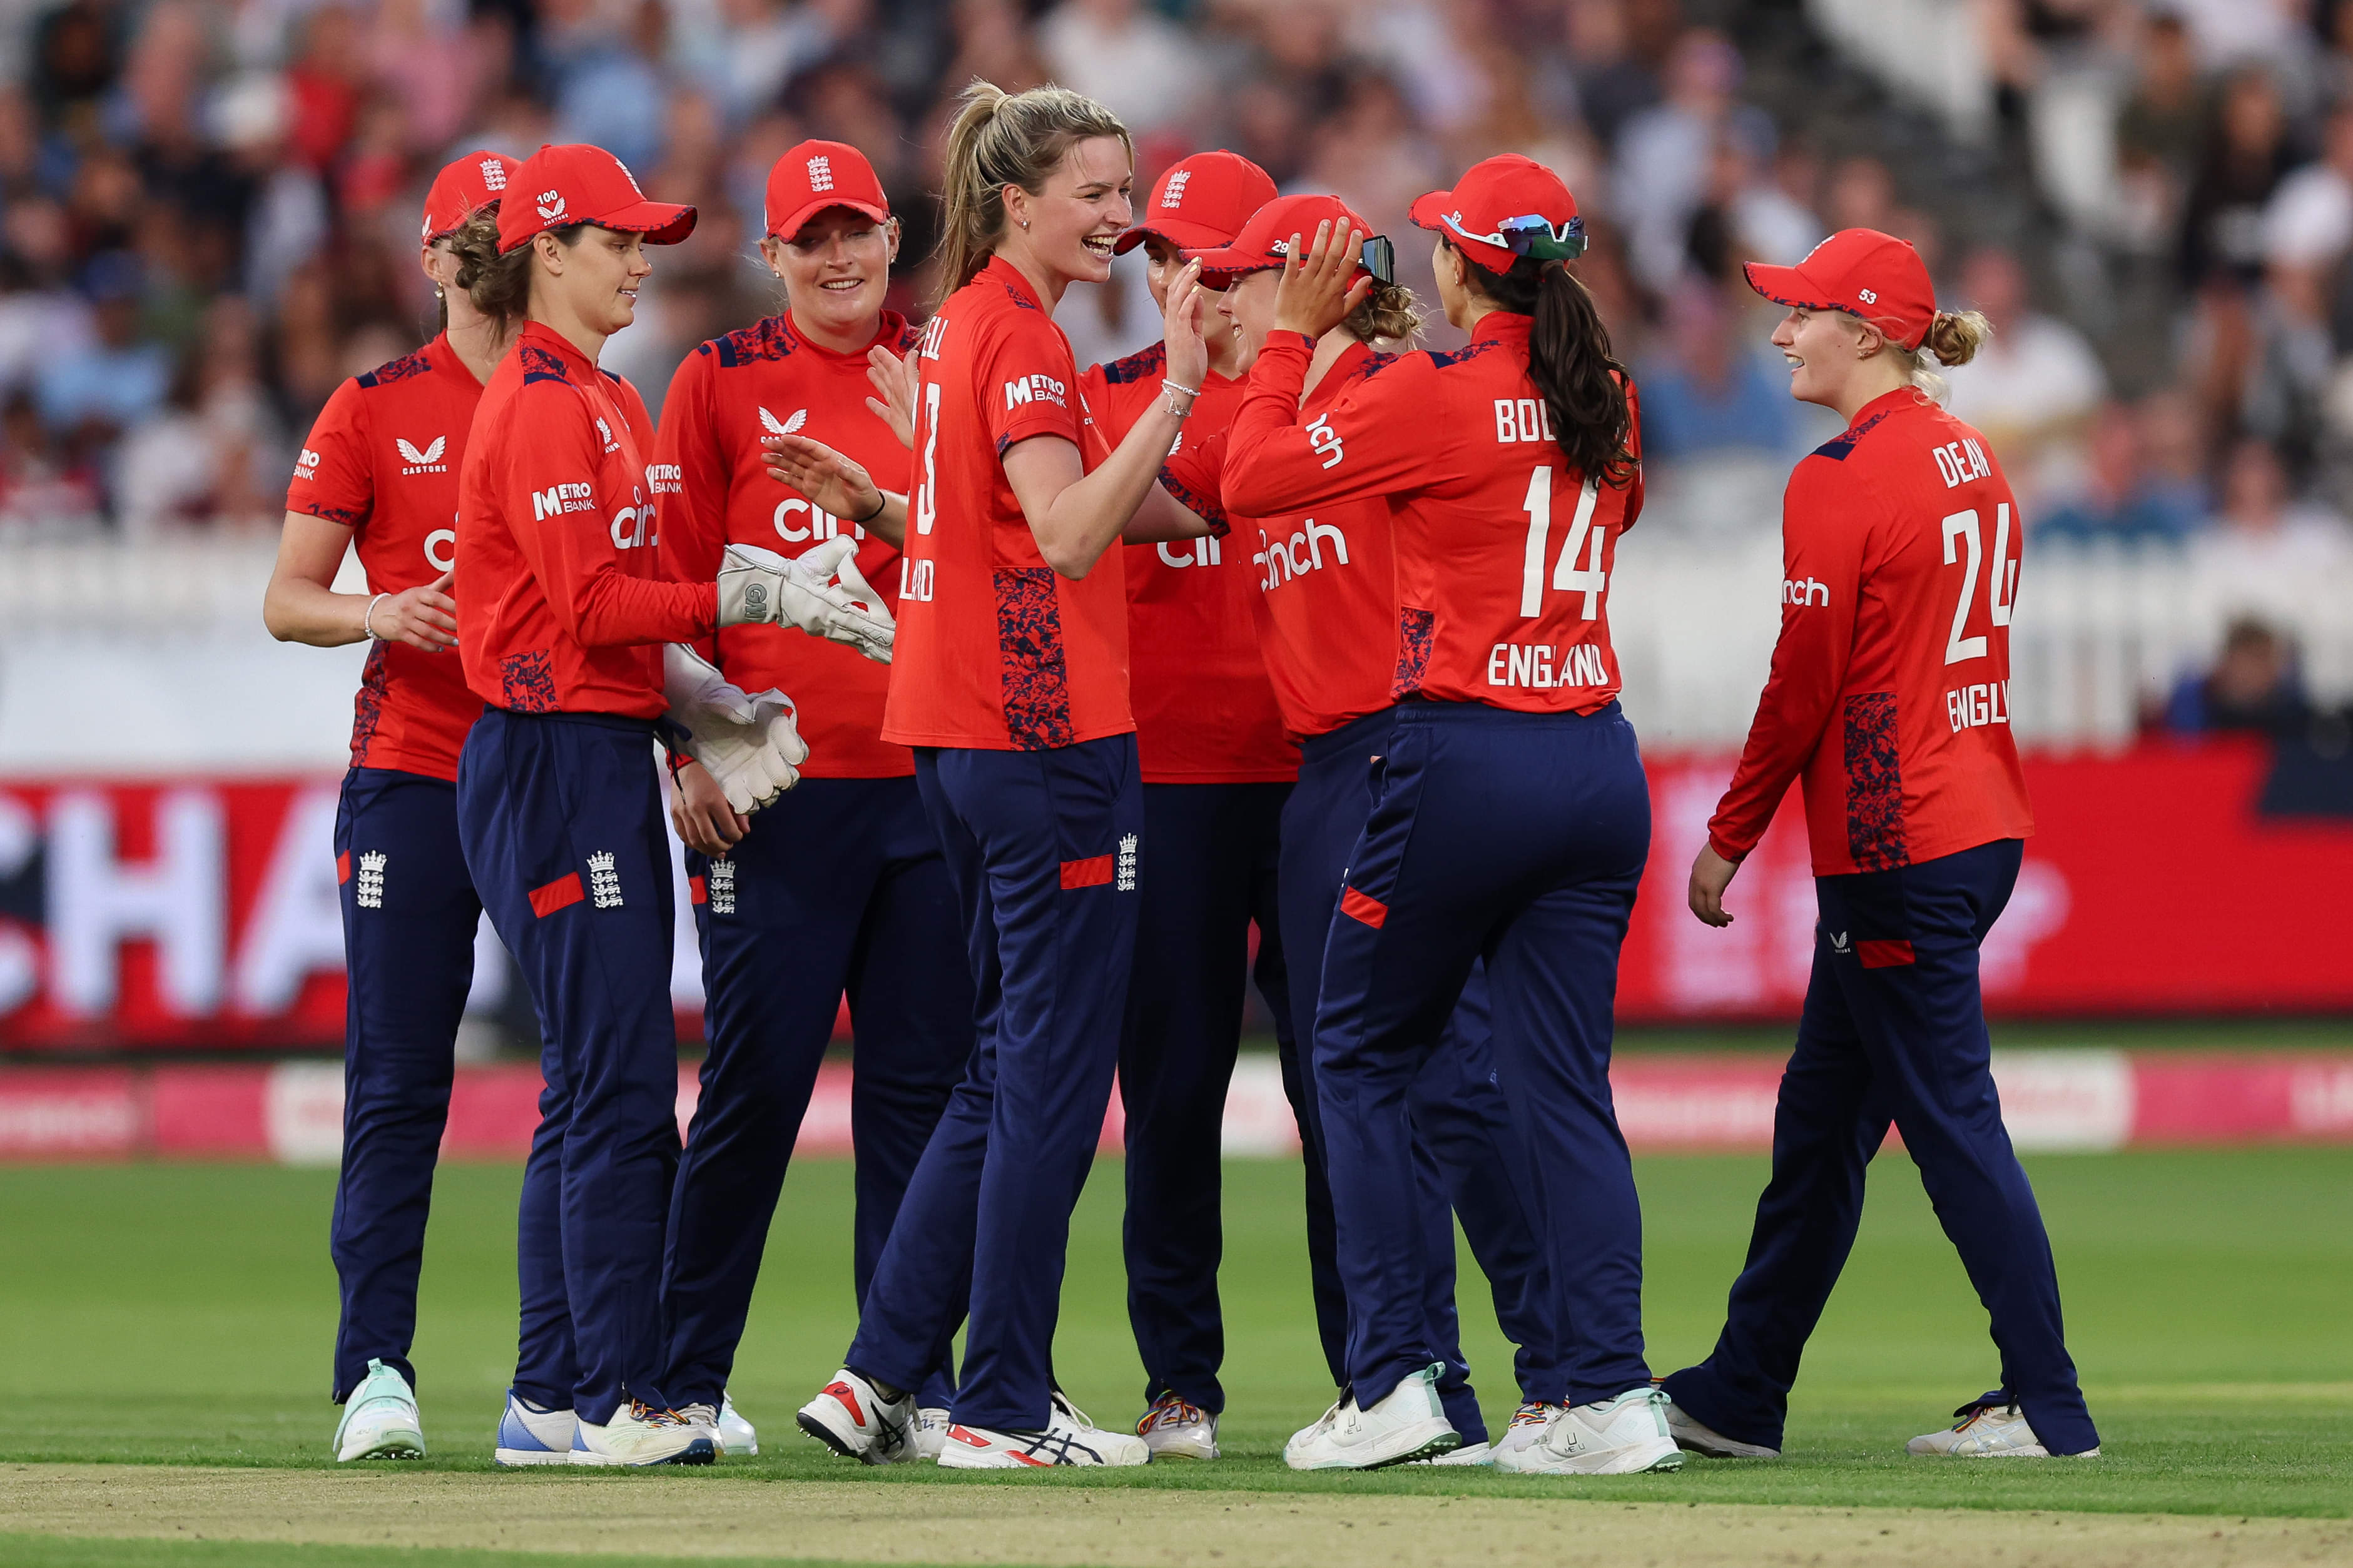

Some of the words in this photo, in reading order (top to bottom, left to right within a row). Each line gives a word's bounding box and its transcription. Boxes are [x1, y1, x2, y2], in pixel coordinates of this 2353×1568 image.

[537, 190, 558, 205] 100
[1451, 210, 1462, 225] 52
[1271, 240, 1289, 253] 29
[1859, 288, 1877, 305] 53
[921, 315, 949, 361] ELL
[1005, 374, 1065, 411] METRO
[1034, 390, 1067, 409] BANK
[402, 465, 447, 475] CASTORE
[1933, 438, 1991, 488] DEAN
[293, 465, 315, 481] ANK
[655, 482, 683, 493] BANK
[532, 482, 591, 521] METRO
[564, 499, 596, 513] BANK
[1520, 465, 1605, 620] 14
[1783, 576, 1829, 607] nch
[1941, 502, 2016, 666] 24
[1488, 643, 1608, 687] ENGAND
